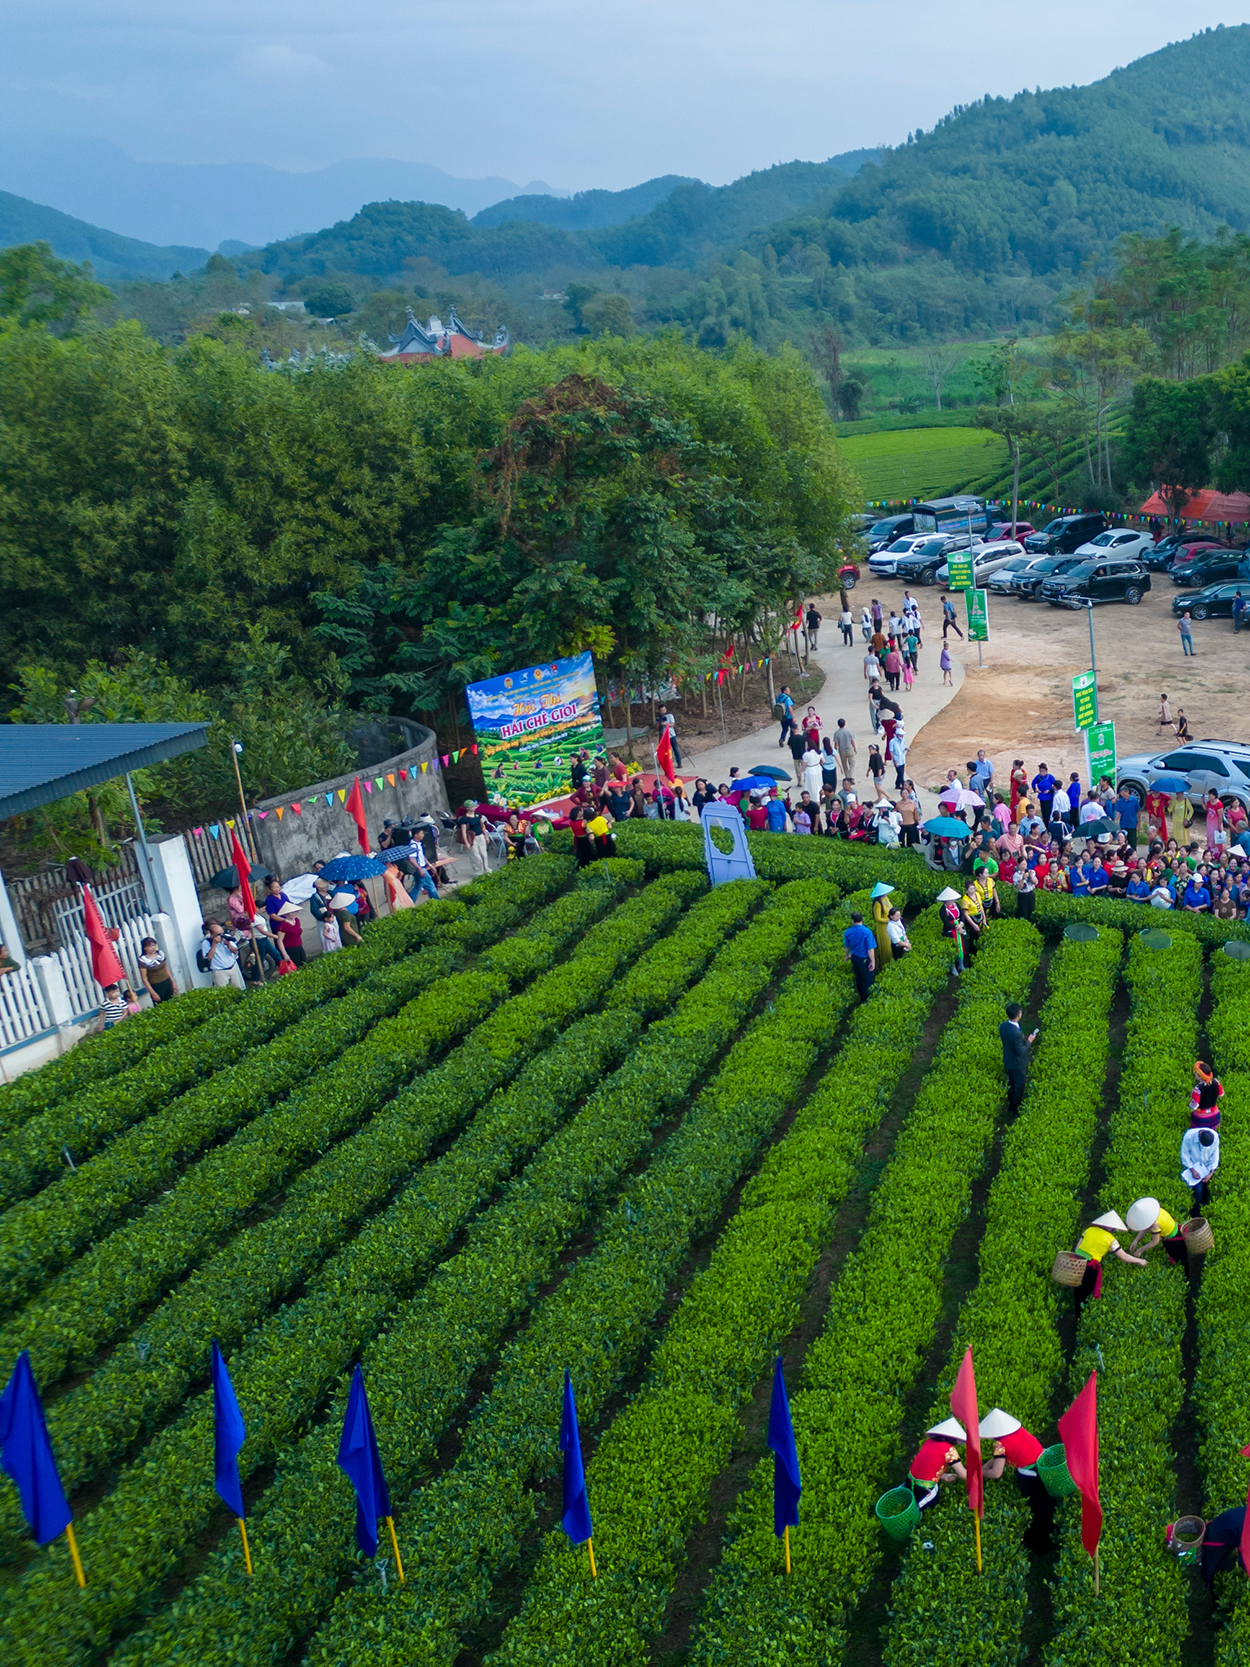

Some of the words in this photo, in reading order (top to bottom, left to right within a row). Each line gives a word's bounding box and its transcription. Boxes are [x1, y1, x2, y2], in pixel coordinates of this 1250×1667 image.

[512, 701, 536, 716] Hội
[540, 692, 561, 708] Thi
[502, 721, 523, 737] HÁI
[526, 711, 548, 728] CHÈ
